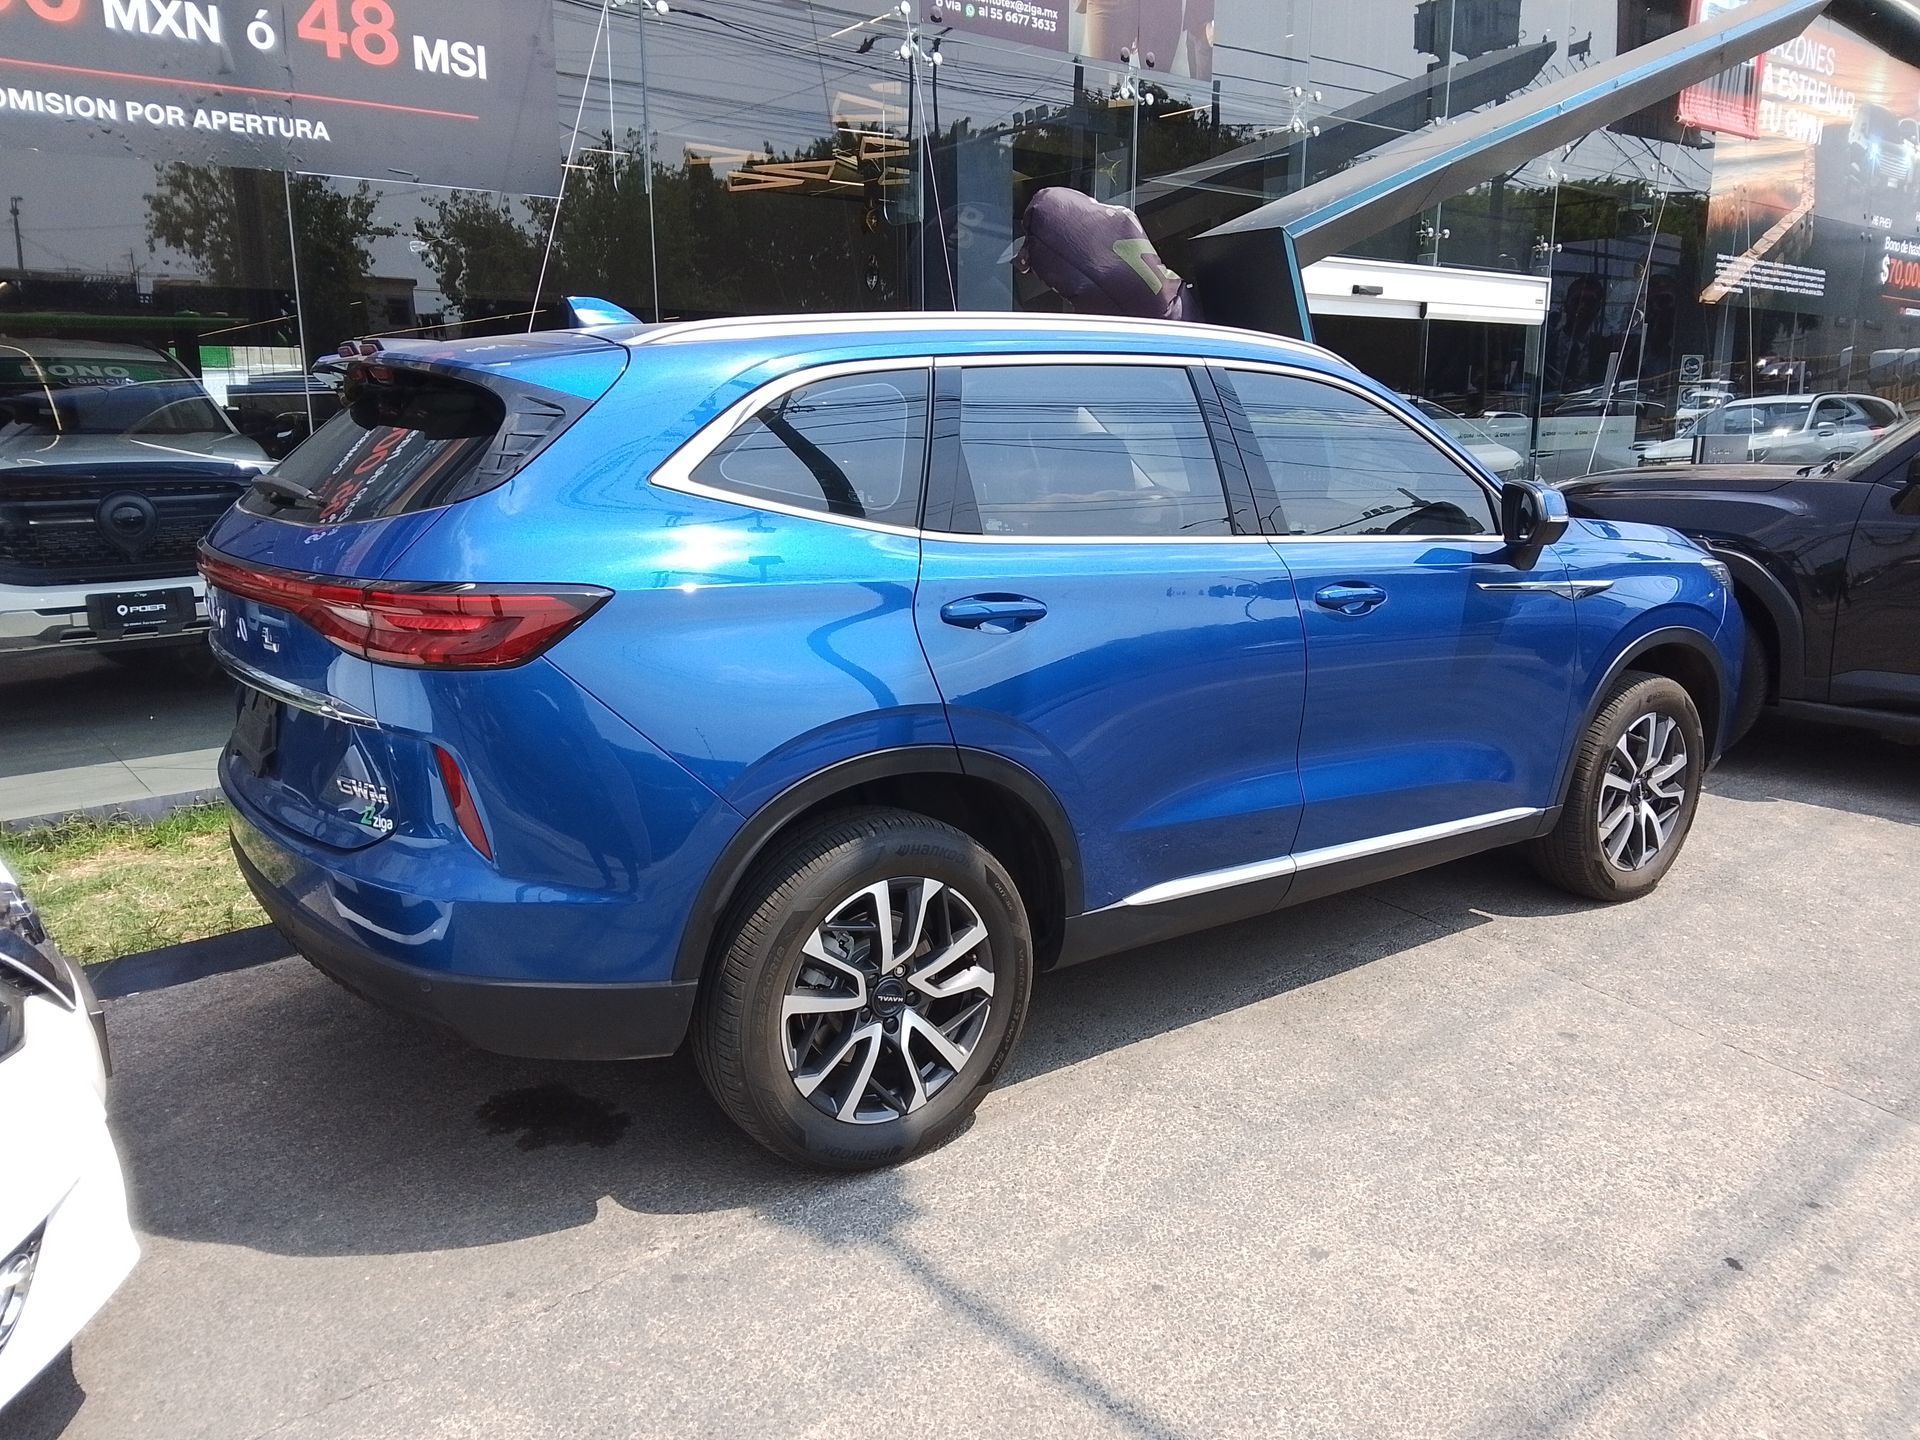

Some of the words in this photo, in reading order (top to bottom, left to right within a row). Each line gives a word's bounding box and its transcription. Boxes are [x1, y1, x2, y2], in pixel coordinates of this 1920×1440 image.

[978, 6, 988, 18] al
[990, 8, 1003, 20] 55
[1005, 11, 1029, 27] 6677
[1031, 16, 1057, 32] 3633
[103, 0, 222, 43] MXN
[247, 9, 275, 49] ó
[297, 0, 399, 65] 48
[413, 35, 487, 80] MSI
[1770, 36, 1836, 76] AZONES
[126, 100, 185, 126] POR
[193, 109, 331, 142] APERTURA
[1884, 236, 1900, 252] Bono
[1900, 240, 1908, 254] de
[1880, 253, 1920, 290] $70,00
[129, 603, 167, 614] POER
